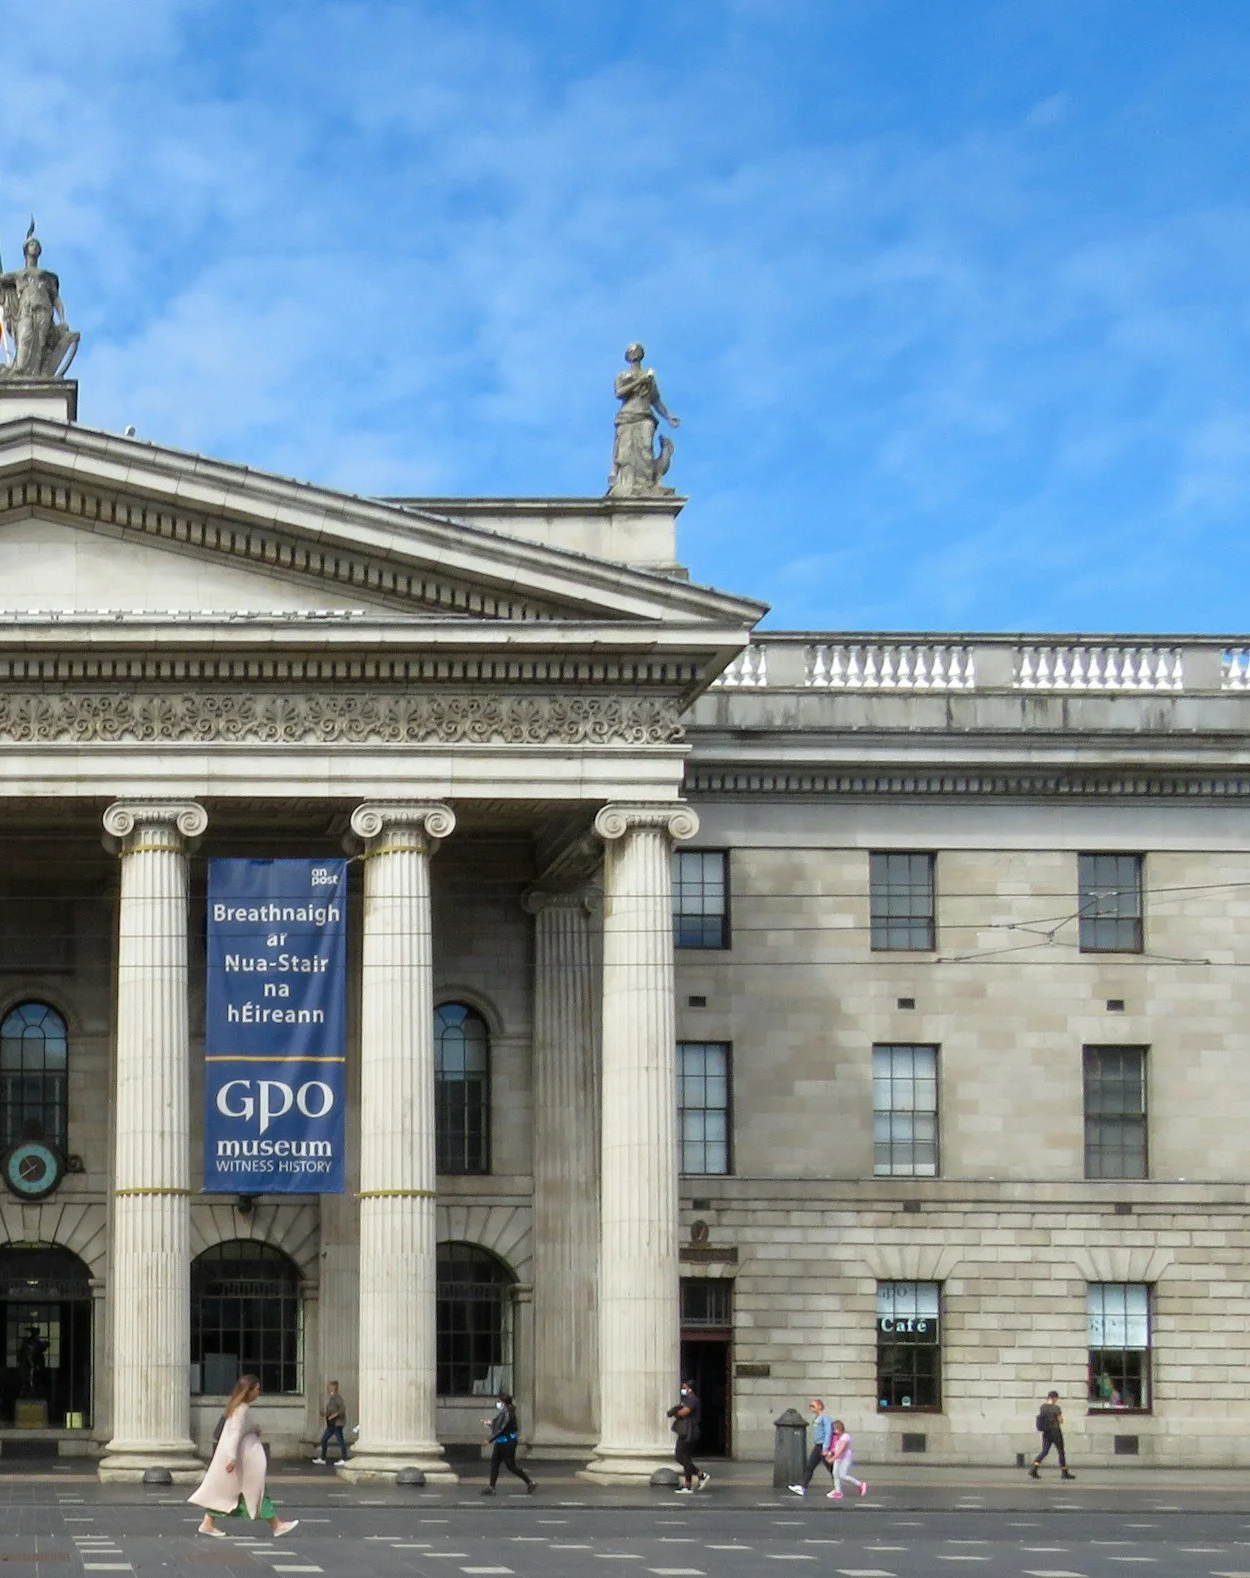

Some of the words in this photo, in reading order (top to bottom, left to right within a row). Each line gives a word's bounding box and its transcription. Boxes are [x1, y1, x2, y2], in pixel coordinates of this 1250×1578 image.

[311, 868, 327, 877] an
[311, 875, 338, 887] post
[214, 904, 340, 926] Breathnaigh
[267, 933, 287, 947] ar
[225, 954, 329, 973] Nua-Stair
[264, 983, 289, 998] na
[227, 1001, 324, 1024] hÉireann
[216, 1080, 334, 1135] GPO
[217, 1140, 332, 1157] museum
[216, 1160, 274, 1172] WITNESS
[279, 1160, 332, 1172] HISTORY
[881, 1317, 927, 1332] Café
